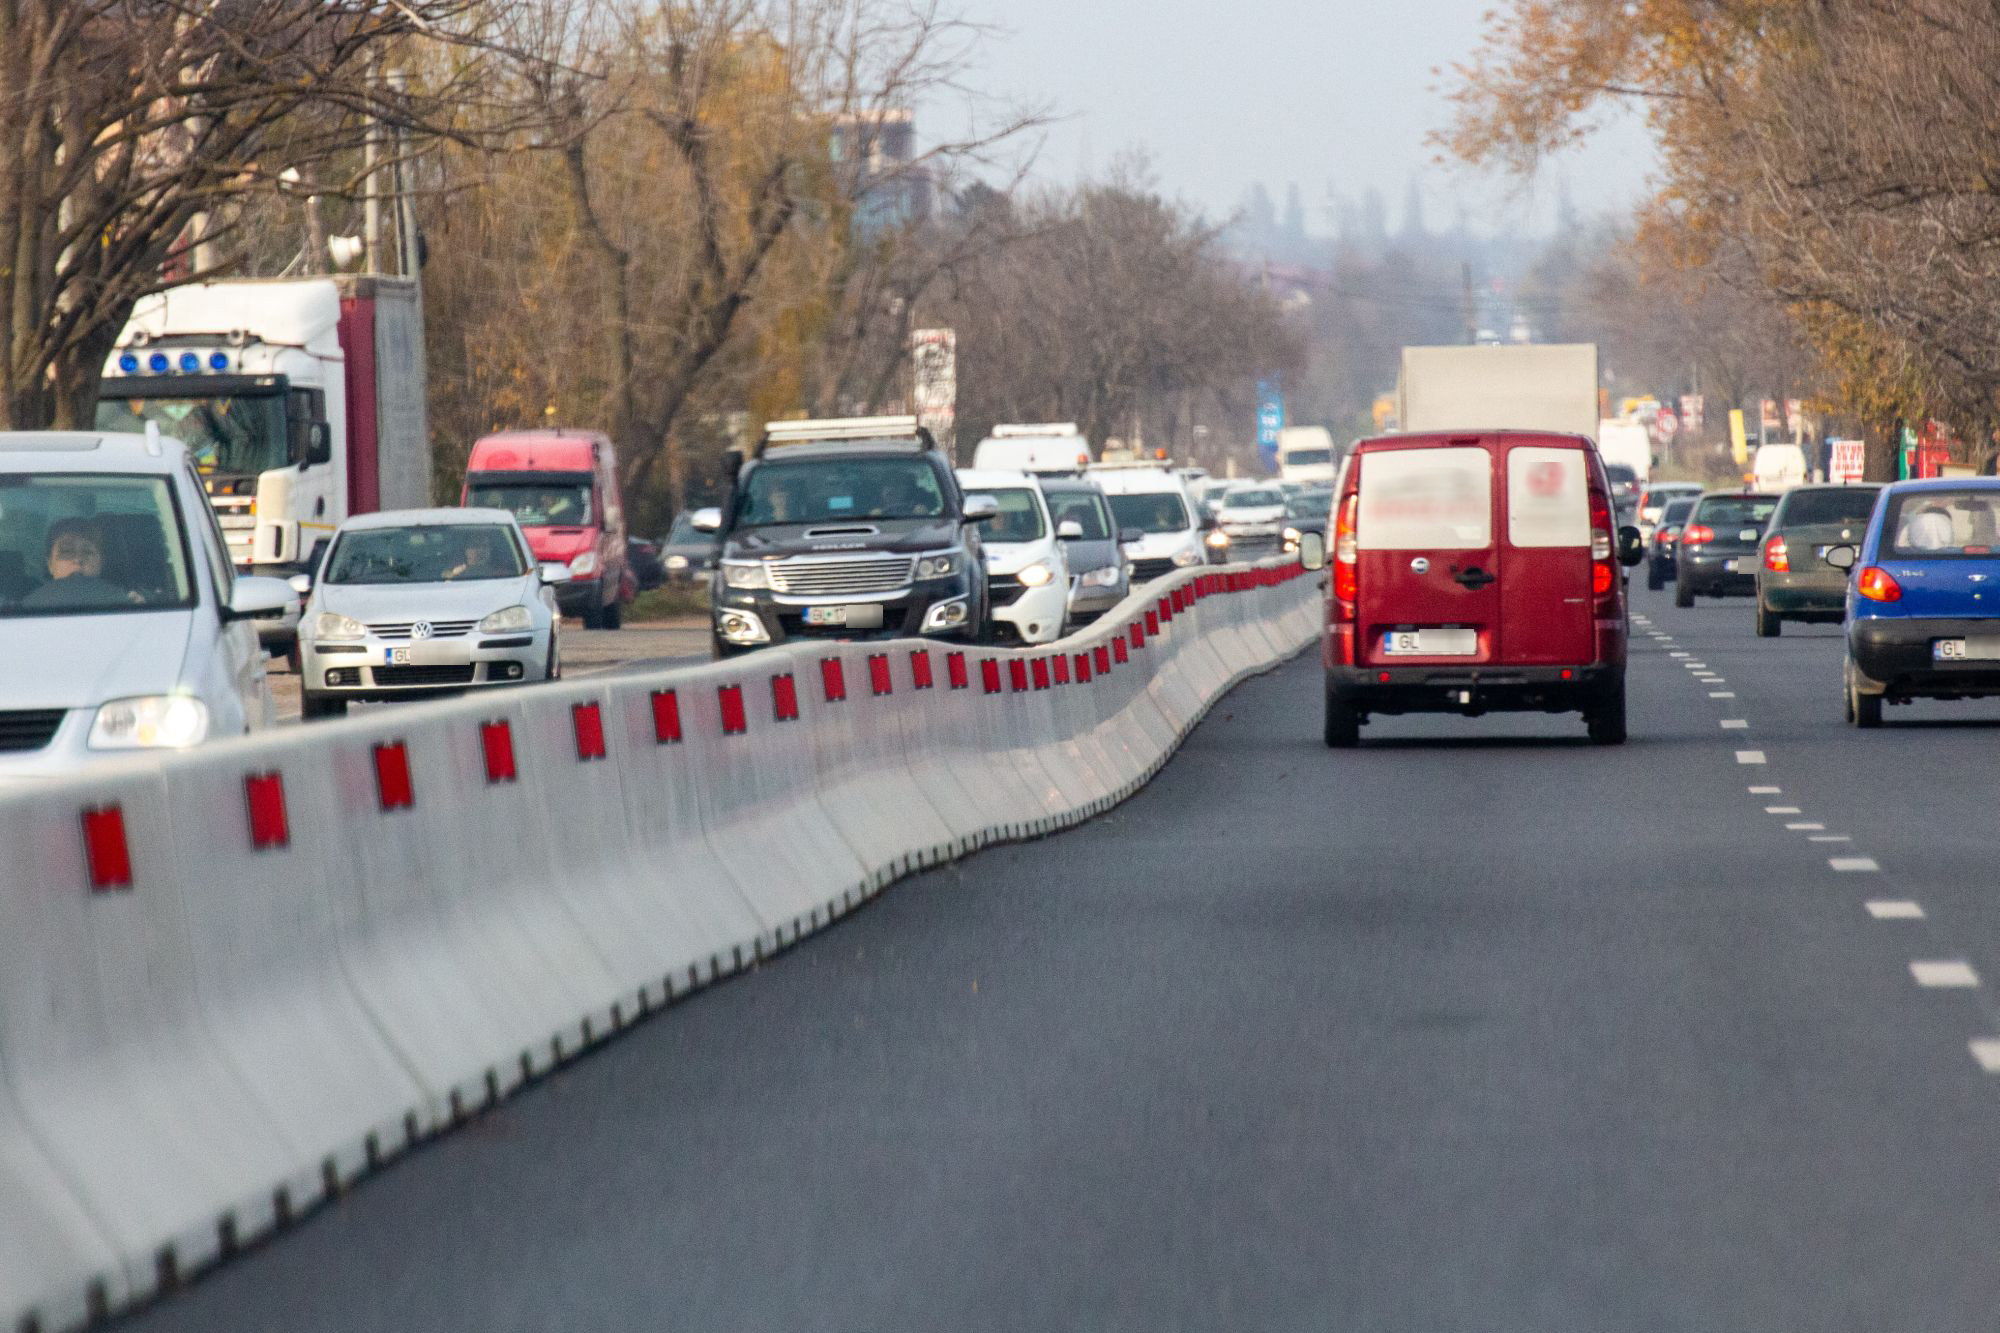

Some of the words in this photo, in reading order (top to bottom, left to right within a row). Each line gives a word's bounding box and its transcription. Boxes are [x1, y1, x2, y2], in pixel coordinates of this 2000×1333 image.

[1398, 634, 1419, 649] GL
[1942, 641, 1963, 656] GL
[394, 649, 410, 662] GL
